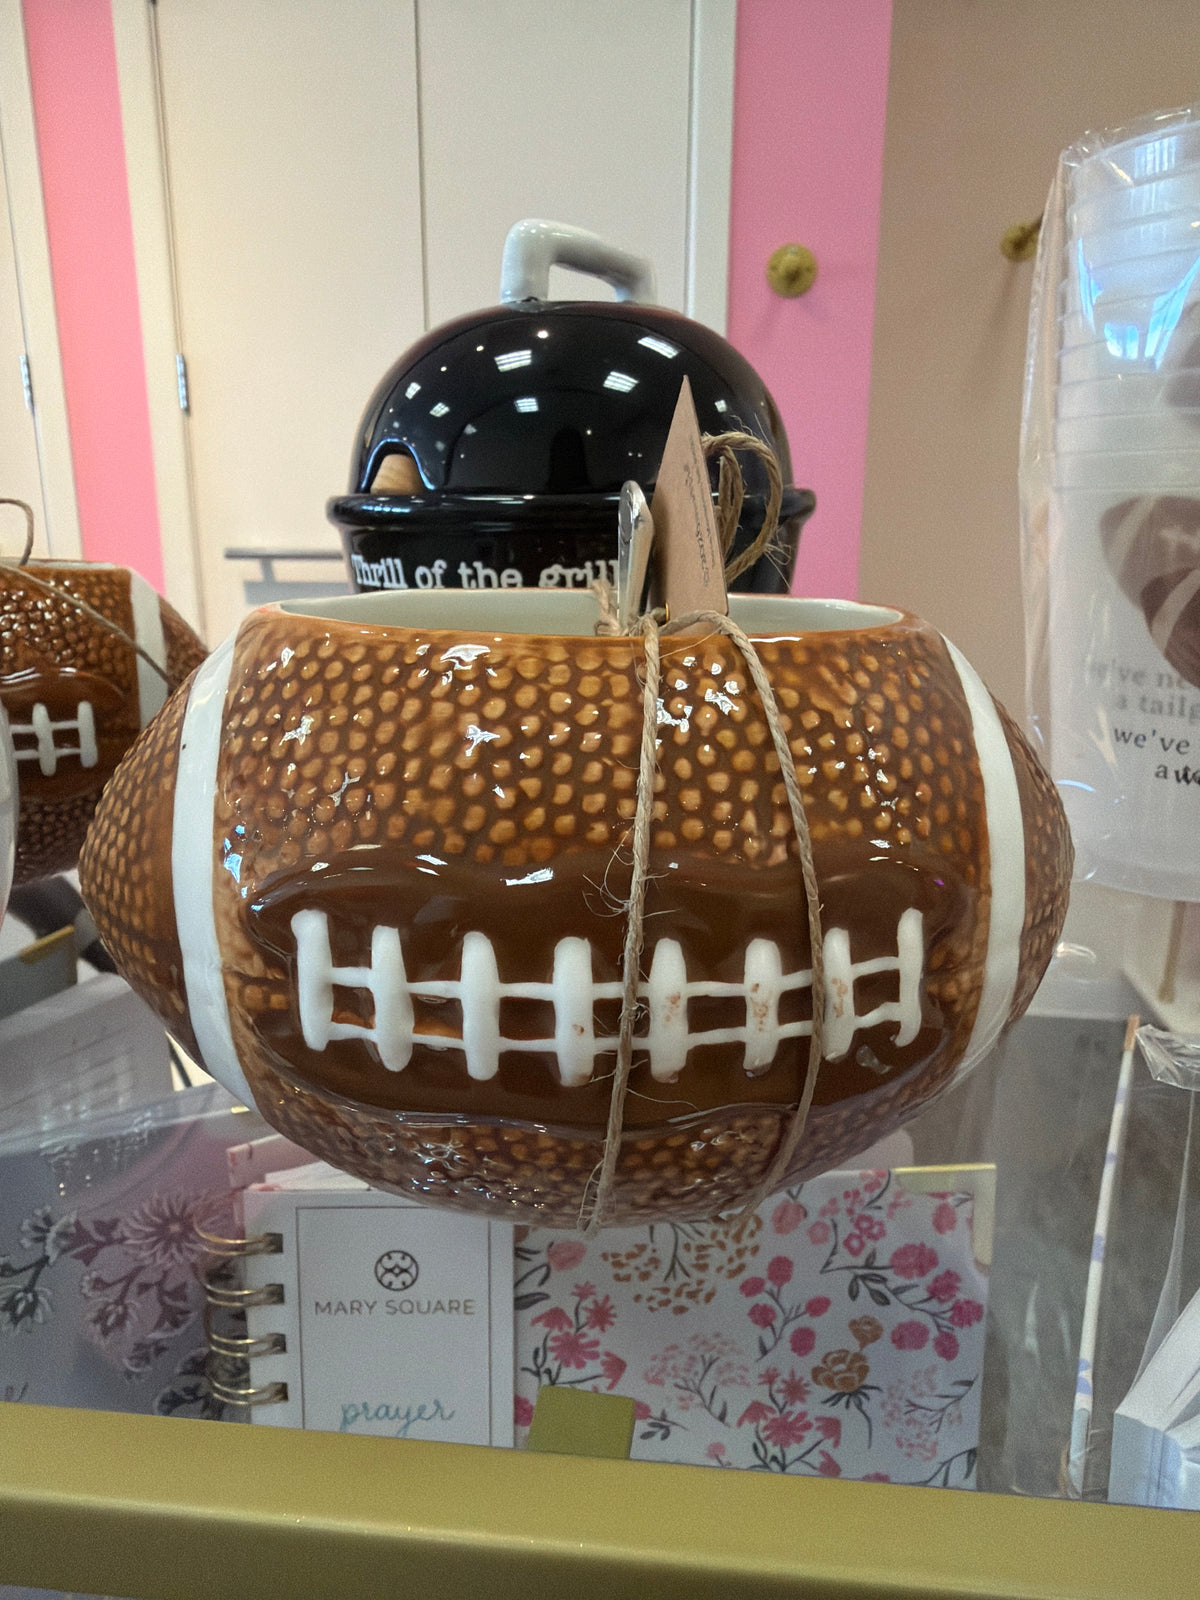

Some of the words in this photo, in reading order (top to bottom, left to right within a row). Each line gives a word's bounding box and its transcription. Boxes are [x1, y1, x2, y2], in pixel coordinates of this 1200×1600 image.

[351, 553, 408, 589] Thrill
[414, 559, 447, 589] of
[457, 561, 523, 589] the
[538, 559, 619, 589] grill
[1114, 727, 1190, 756] we've
[314, 1300, 377, 1316] MARY
[385, 1298, 476, 1316] SQUARE
[339, 1399, 456, 1438] prayer
